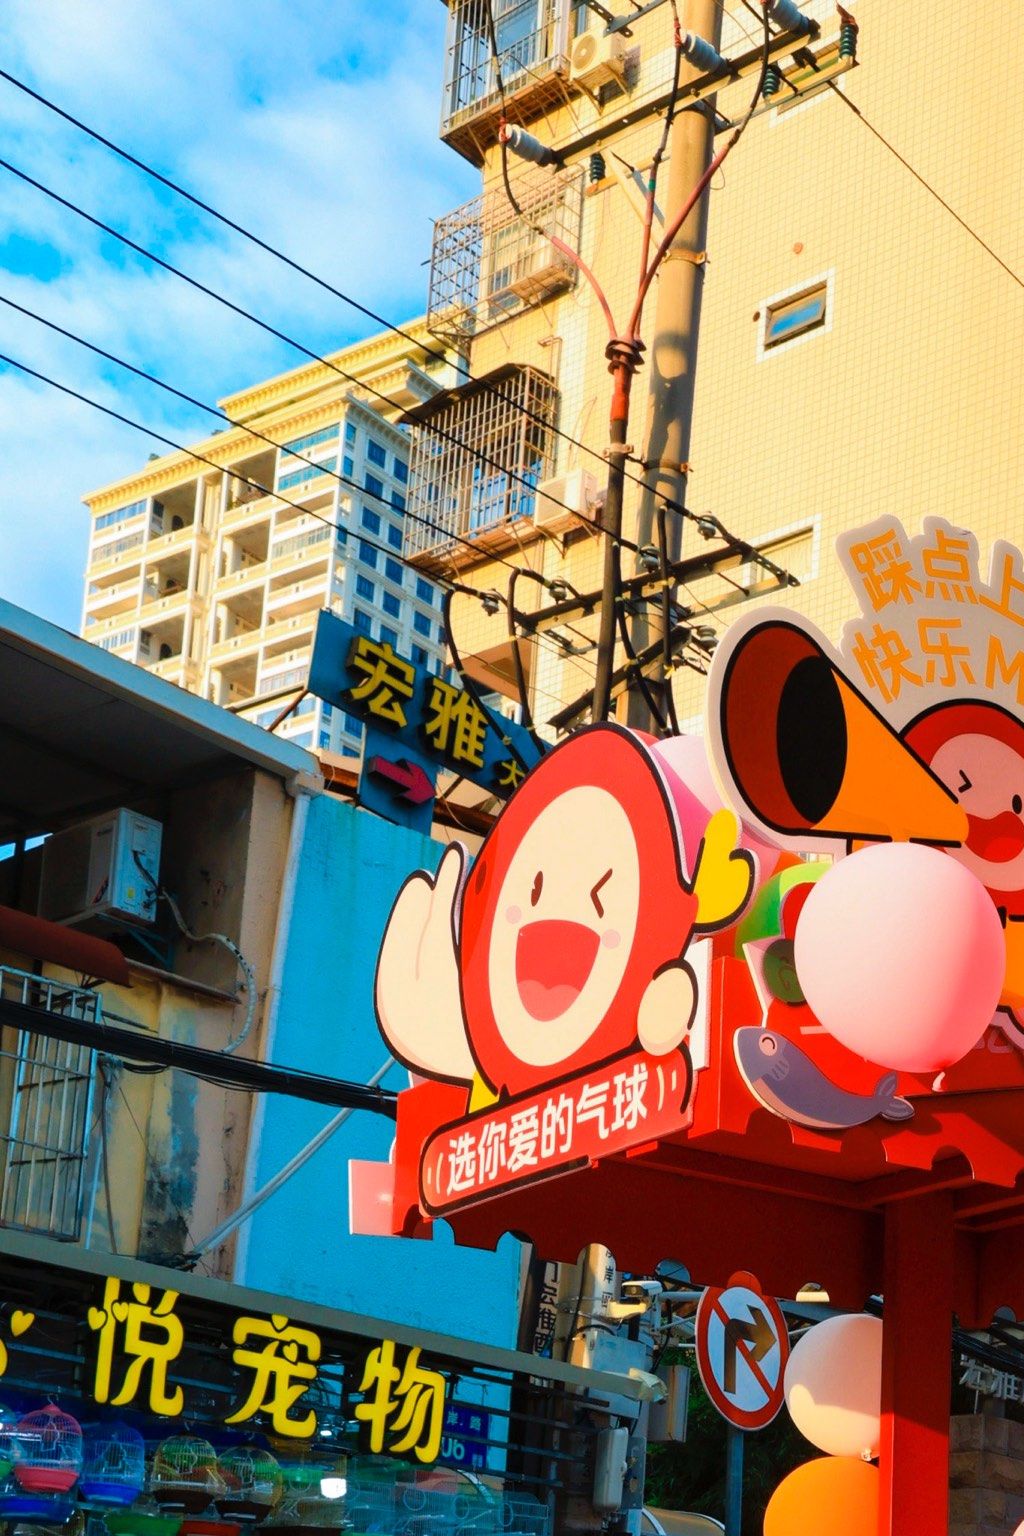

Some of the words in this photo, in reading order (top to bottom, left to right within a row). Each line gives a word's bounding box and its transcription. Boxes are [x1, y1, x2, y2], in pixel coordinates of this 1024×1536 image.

[445, 1062, 648, 1194] 选你爱的气球
[92, 1275, 447, 1465] 悦宠物
